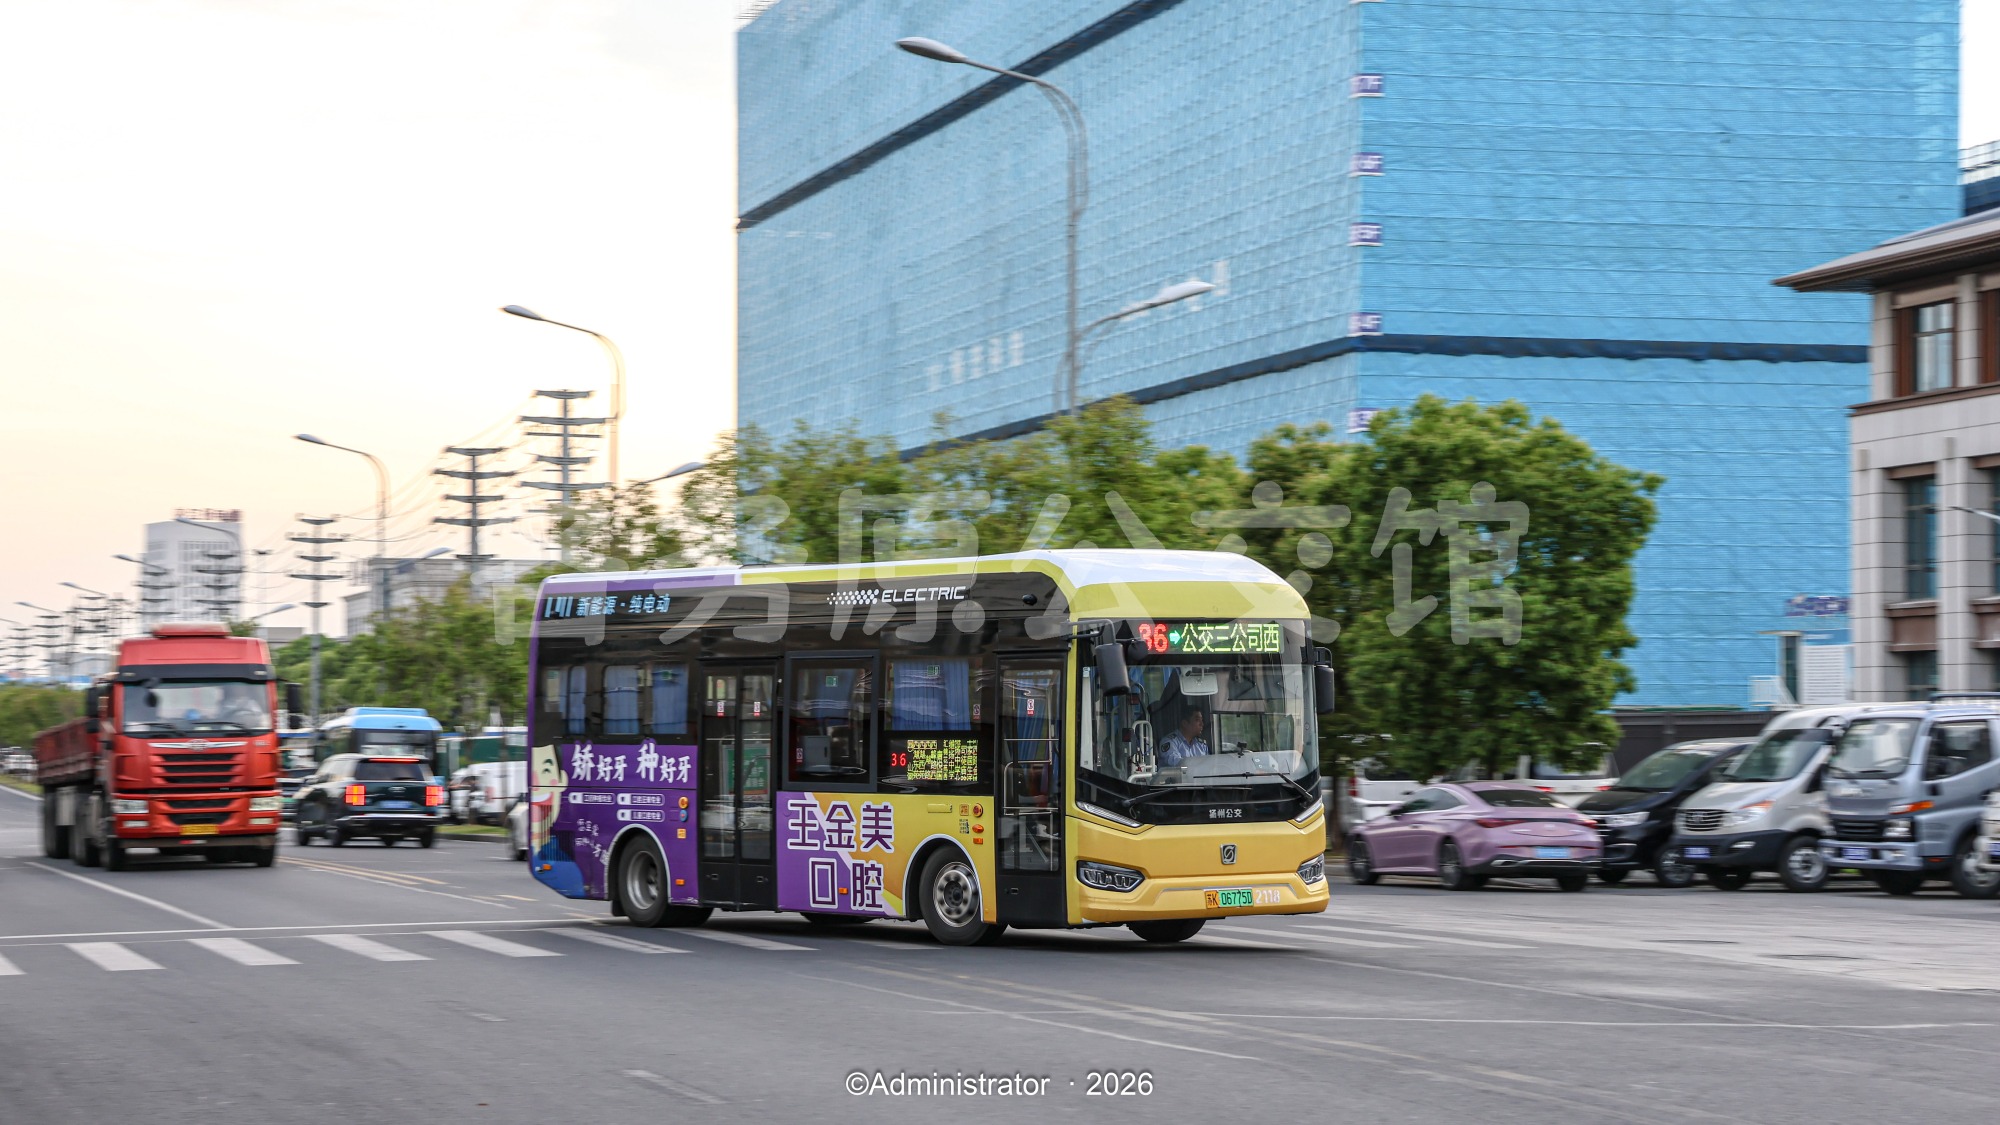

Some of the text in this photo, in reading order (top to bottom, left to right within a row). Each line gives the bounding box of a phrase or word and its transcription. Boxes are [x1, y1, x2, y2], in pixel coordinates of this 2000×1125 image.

[881, 586, 967, 603] ELECTRIC
[1138, 622, 1280, 653] 36 公交三公司西
[891, 753, 907, 767] 36
[1209, 808, 1242, 819] 扬州公交
[788, 800, 894, 853] 王金美
[809, 858, 884, 911] 口腔
[1256, 889, 1280, 904] 2118
